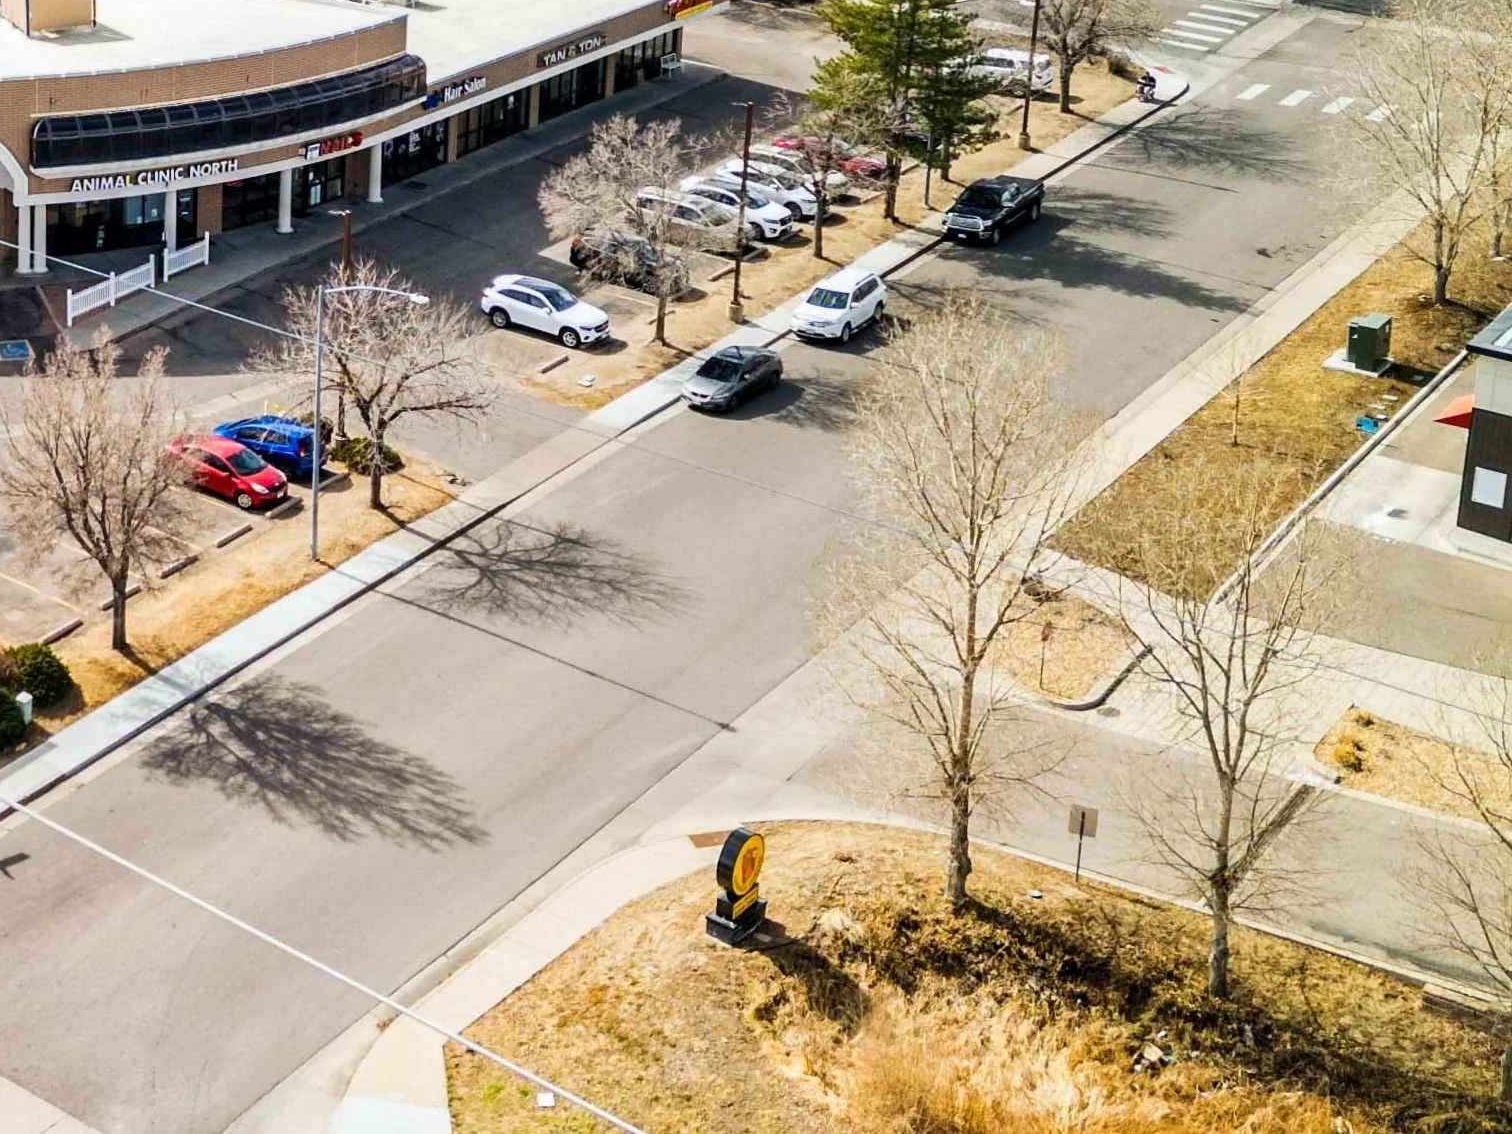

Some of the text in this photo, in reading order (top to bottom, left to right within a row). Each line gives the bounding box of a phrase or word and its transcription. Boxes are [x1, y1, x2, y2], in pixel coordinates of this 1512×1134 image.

[544, 46, 566, 67] TAN
[444, 86, 463, 103] Hair
[464, 77, 486, 94] Salon
[321, 131, 364, 155] NAILS
[70, 159, 238, 192] ANIMAL CLINIC NORTH
